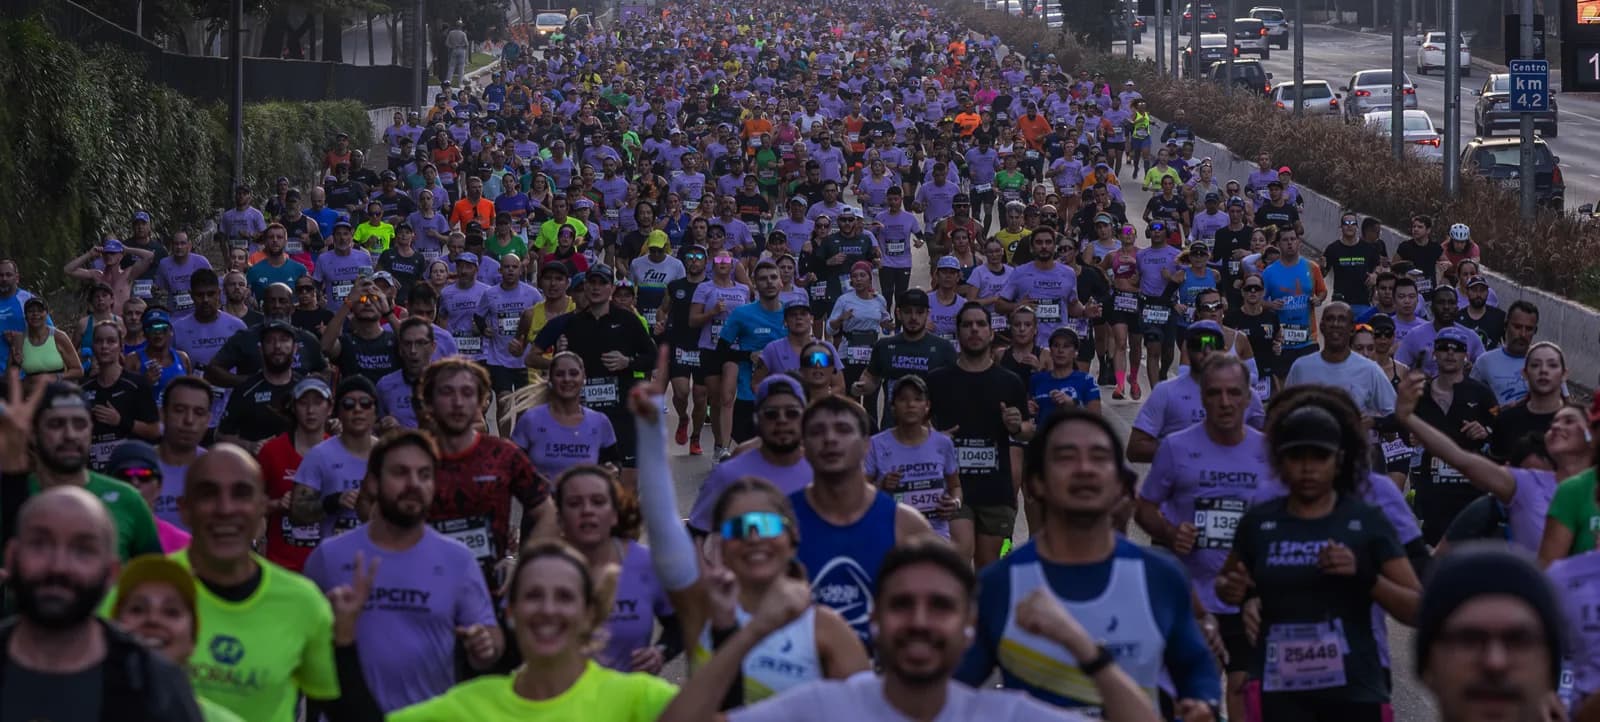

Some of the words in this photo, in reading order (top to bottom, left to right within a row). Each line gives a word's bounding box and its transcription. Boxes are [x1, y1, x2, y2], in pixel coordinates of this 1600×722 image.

[1512, 64, 1546, 72] Centro
[1516, 76, 1542, 90] km
[1516, 94, 1542, 109] 4,2
[643, 269, 666, 282] fun
[587, 386, 614, 396] 10945
[553, 443, 591, 453] SPCITY
[961, 450, 994, 461] 10403
[1209, 471, 1257, 484] SPCITY
[911, 493, 938, 505] 5476
[1267, 555, 1319, 567] MARAT
